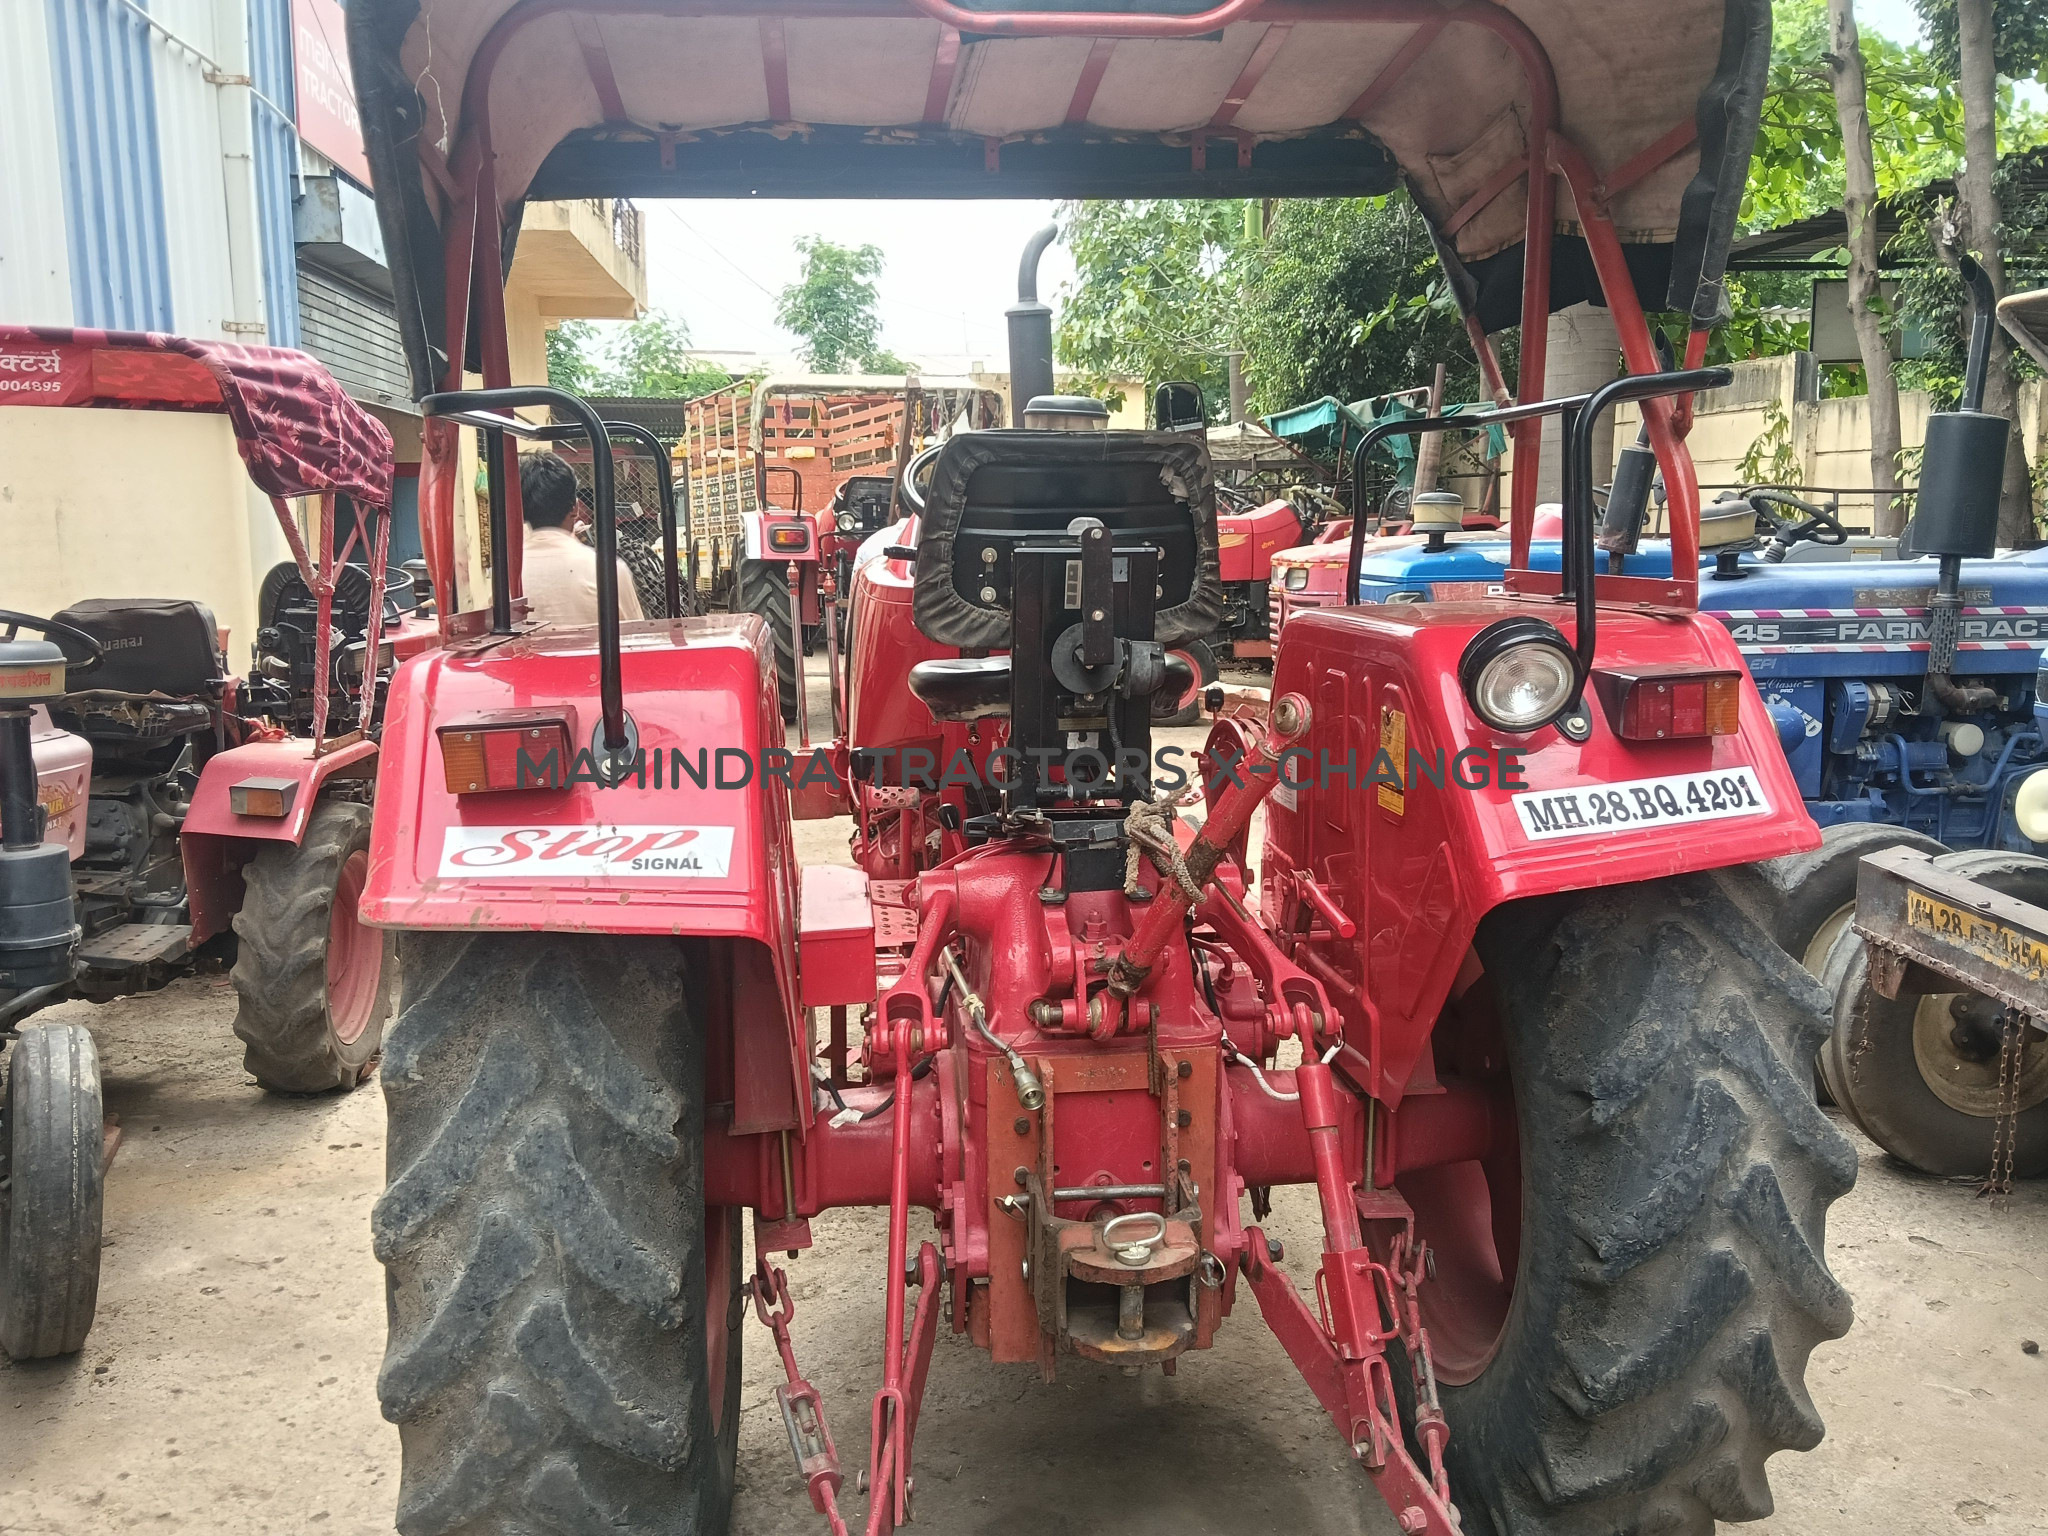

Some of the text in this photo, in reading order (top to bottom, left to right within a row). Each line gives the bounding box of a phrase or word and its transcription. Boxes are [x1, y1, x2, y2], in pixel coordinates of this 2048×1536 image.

[1731, 619, 2039, 642] 45 FARMRAC
[1750, 658, 1778, 671] EPI
[1766, 678, 1803, 690] Classic
[1523, 774, 1761, 833] MH.28.BQ.4291
[449, 829, 700, 867] Stop
[631, 857, 703, 870] SIGNAL
